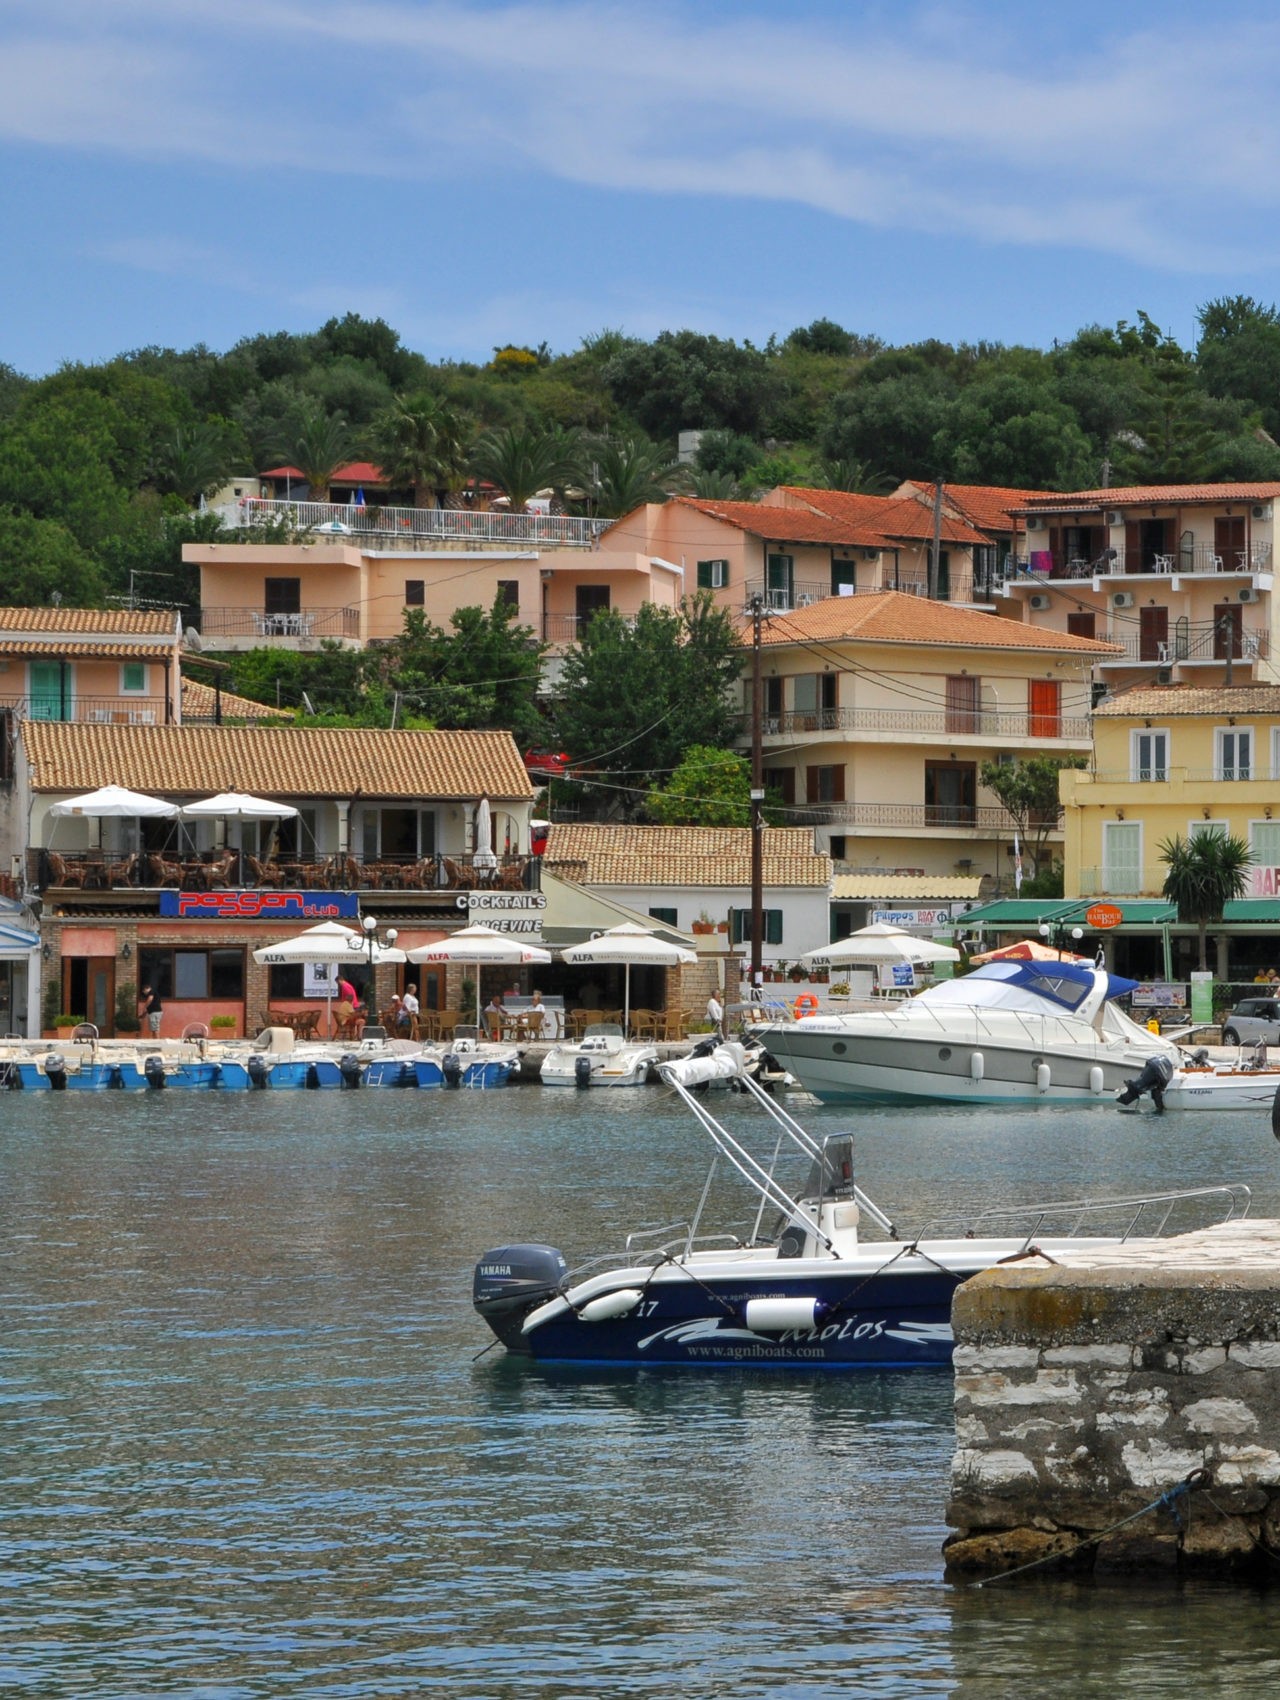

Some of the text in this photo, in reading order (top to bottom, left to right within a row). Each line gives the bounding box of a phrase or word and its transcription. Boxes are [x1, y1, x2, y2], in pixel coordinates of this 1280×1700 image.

[456, 895, 547, 909] COCKTAILS
[263, 954, 286, 962] ALFA
[427, 953, 449, 961] ALFA
[571, 954, 594, 962] ALFA
[811, 957, 831, 965] ALFA
[480, 1265, 511, 1276] YAMAHA
[687, 1344, 825, 1359] www.agniboats.com
